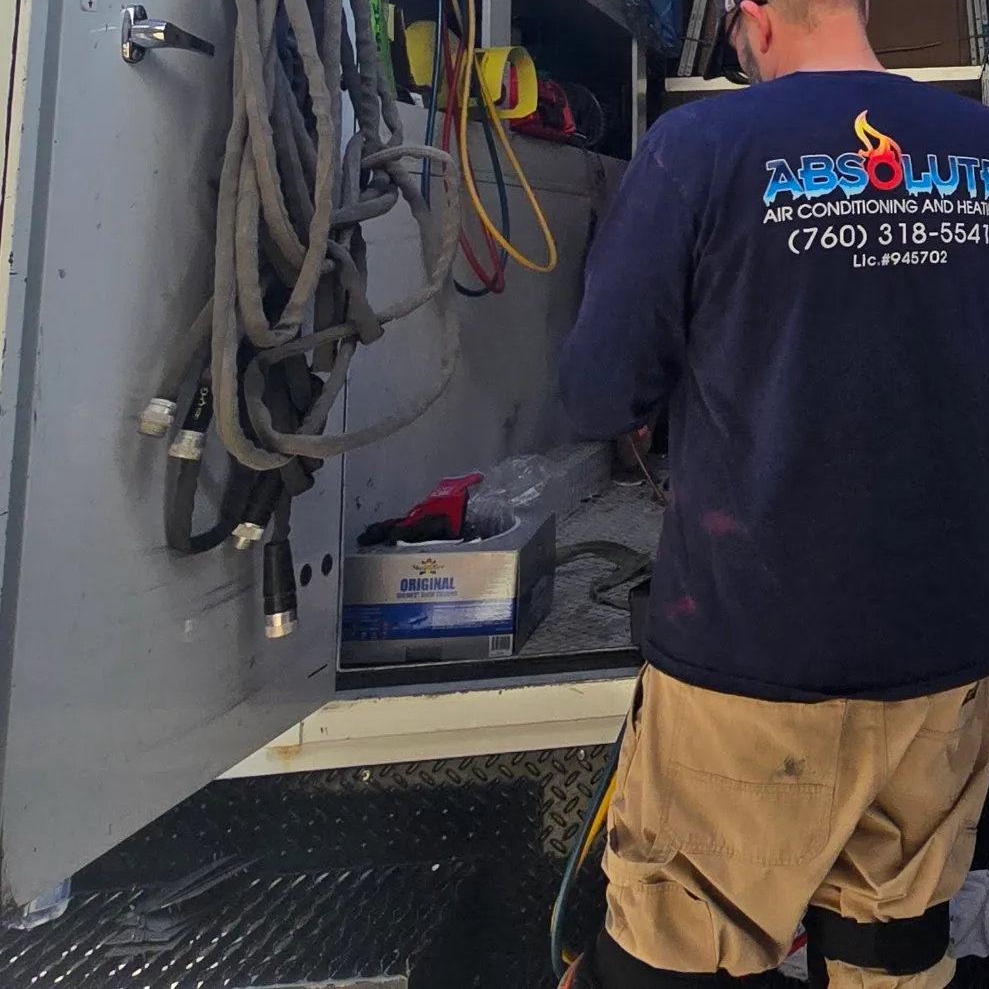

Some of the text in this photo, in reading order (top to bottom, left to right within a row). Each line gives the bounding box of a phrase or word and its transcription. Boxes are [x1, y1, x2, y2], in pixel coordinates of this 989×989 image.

[763, 206, 793, 224] AIR
[797, 198, 918, 219] CONDITIONING
[922, 199, 954, 214] AND
[788, 222, 989, 255] (760) 318-5541
[400, 577, 456, 592] ORIGINAL
